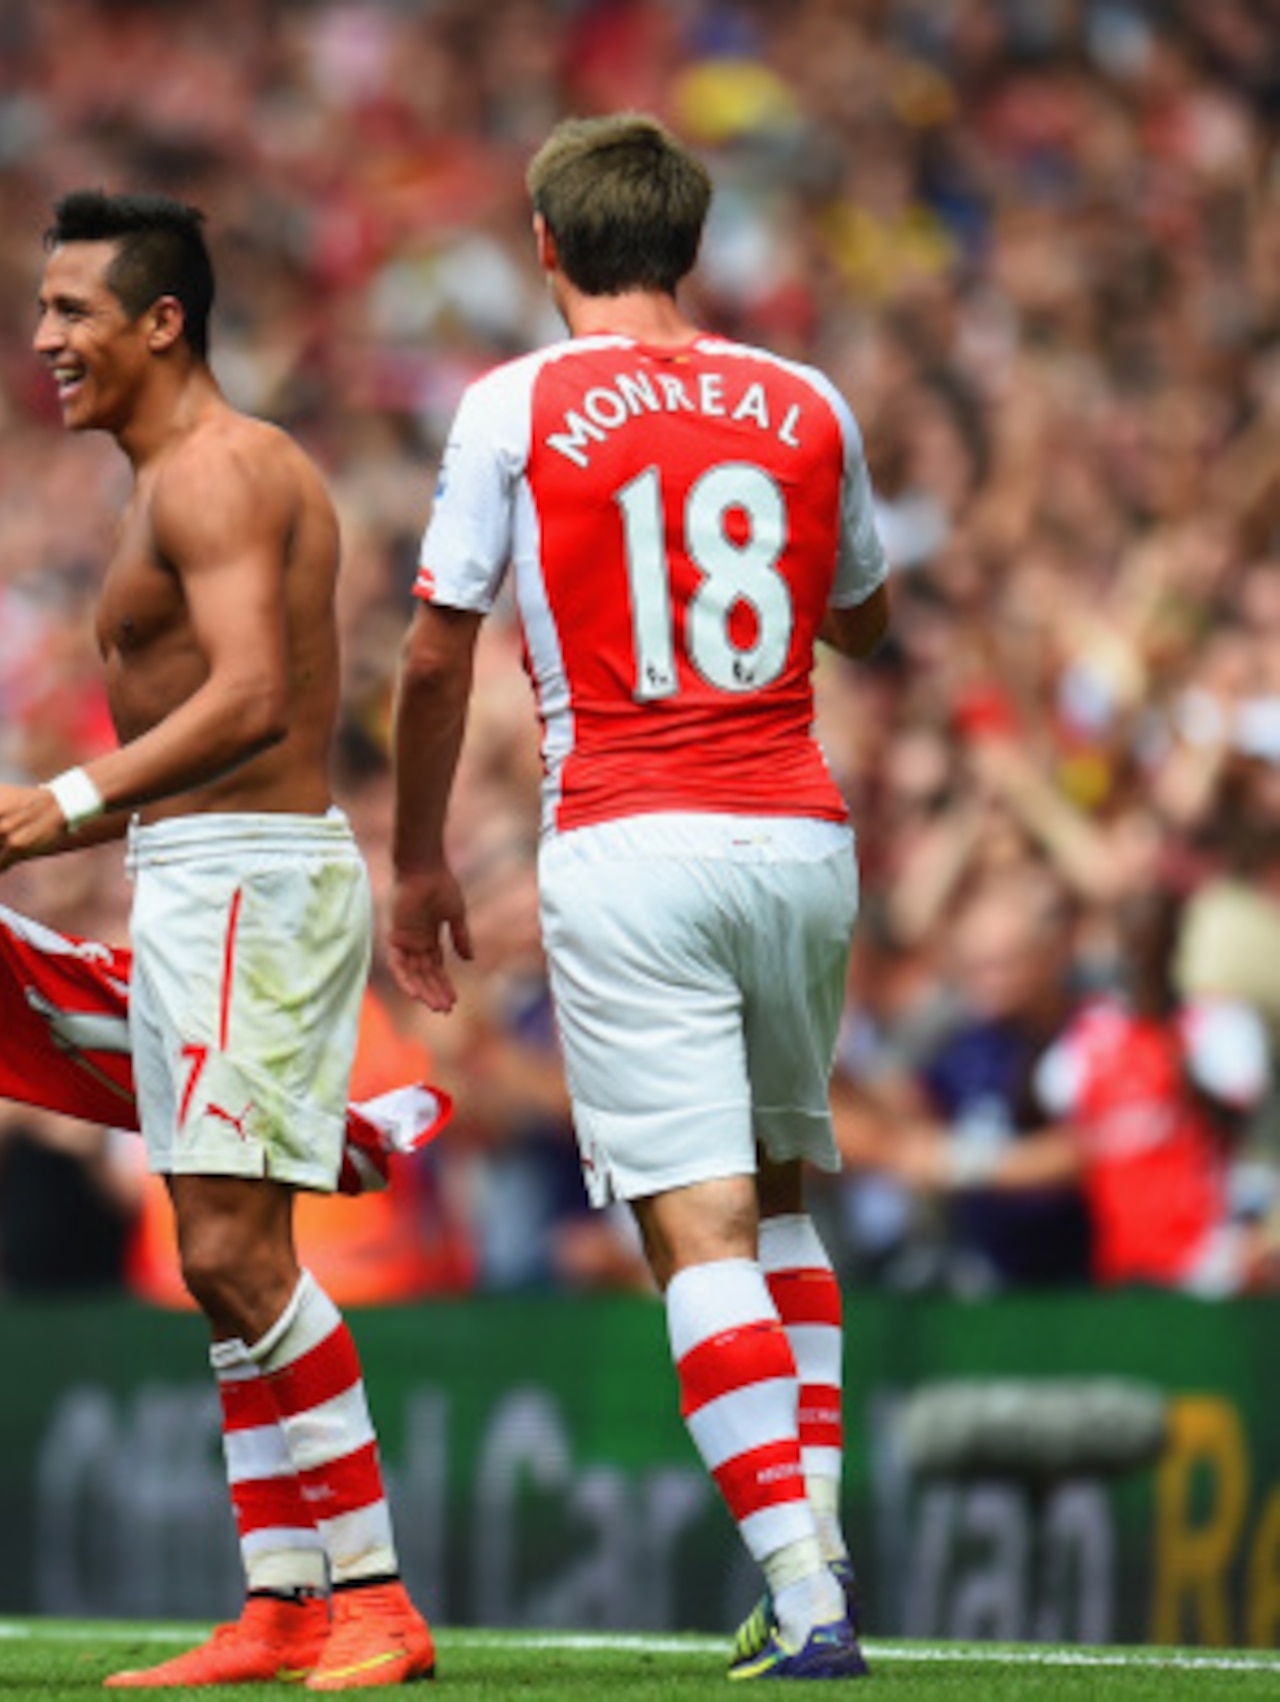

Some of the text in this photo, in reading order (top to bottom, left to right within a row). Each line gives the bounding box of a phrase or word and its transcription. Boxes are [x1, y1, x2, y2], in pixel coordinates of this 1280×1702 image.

[545, 371, 800, 468] MONREAL
[615, 460, 794, 702] 18
[177, 1044, 208, 1133] 7
